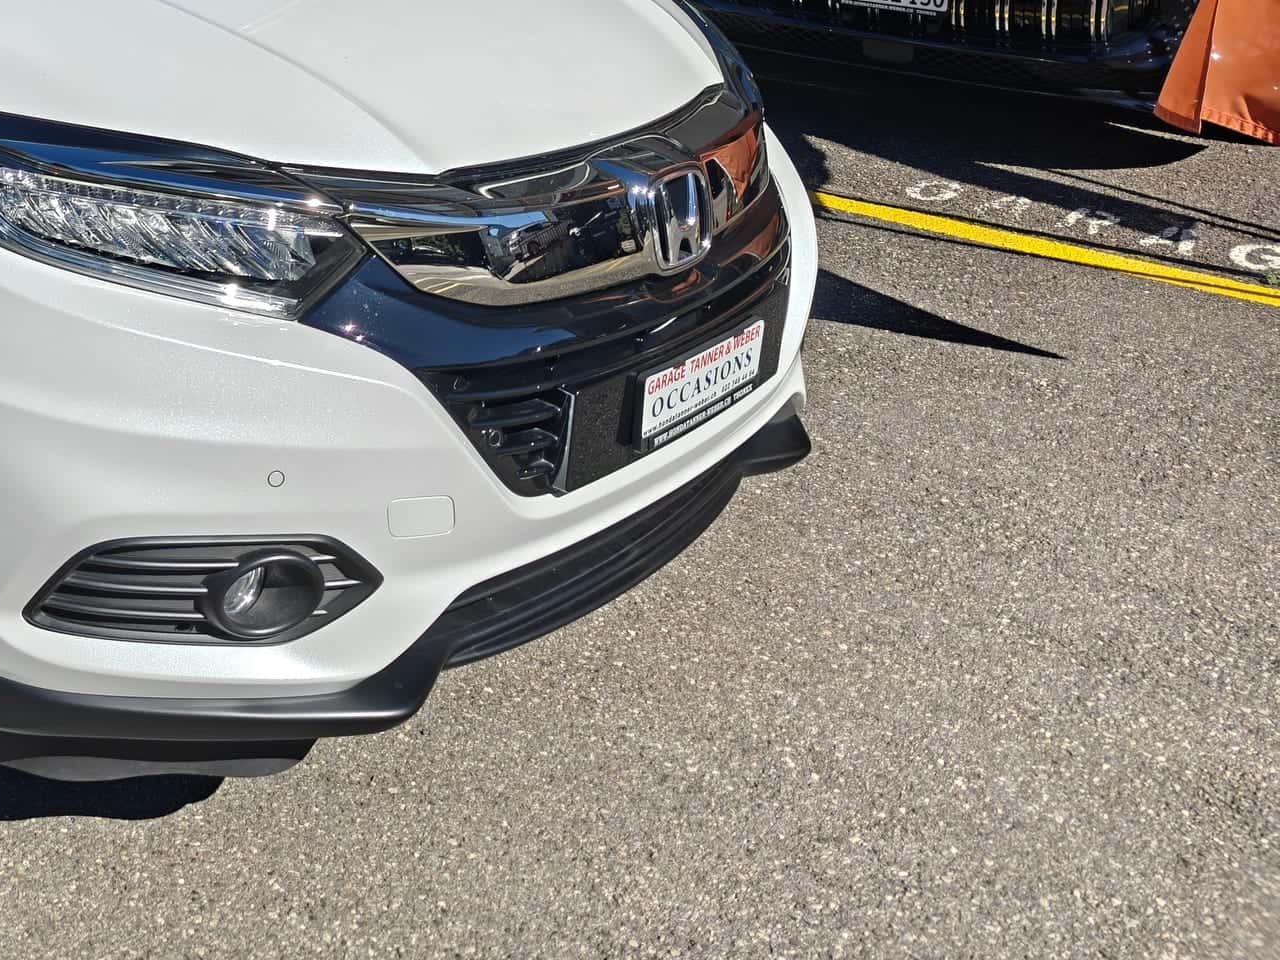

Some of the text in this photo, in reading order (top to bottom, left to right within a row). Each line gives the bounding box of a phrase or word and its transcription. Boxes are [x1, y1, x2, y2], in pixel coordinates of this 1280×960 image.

[647, 325, 761, 396] GARAGE TANNER & WEBER
[652, 346, 753, 418] OCCASIONS
